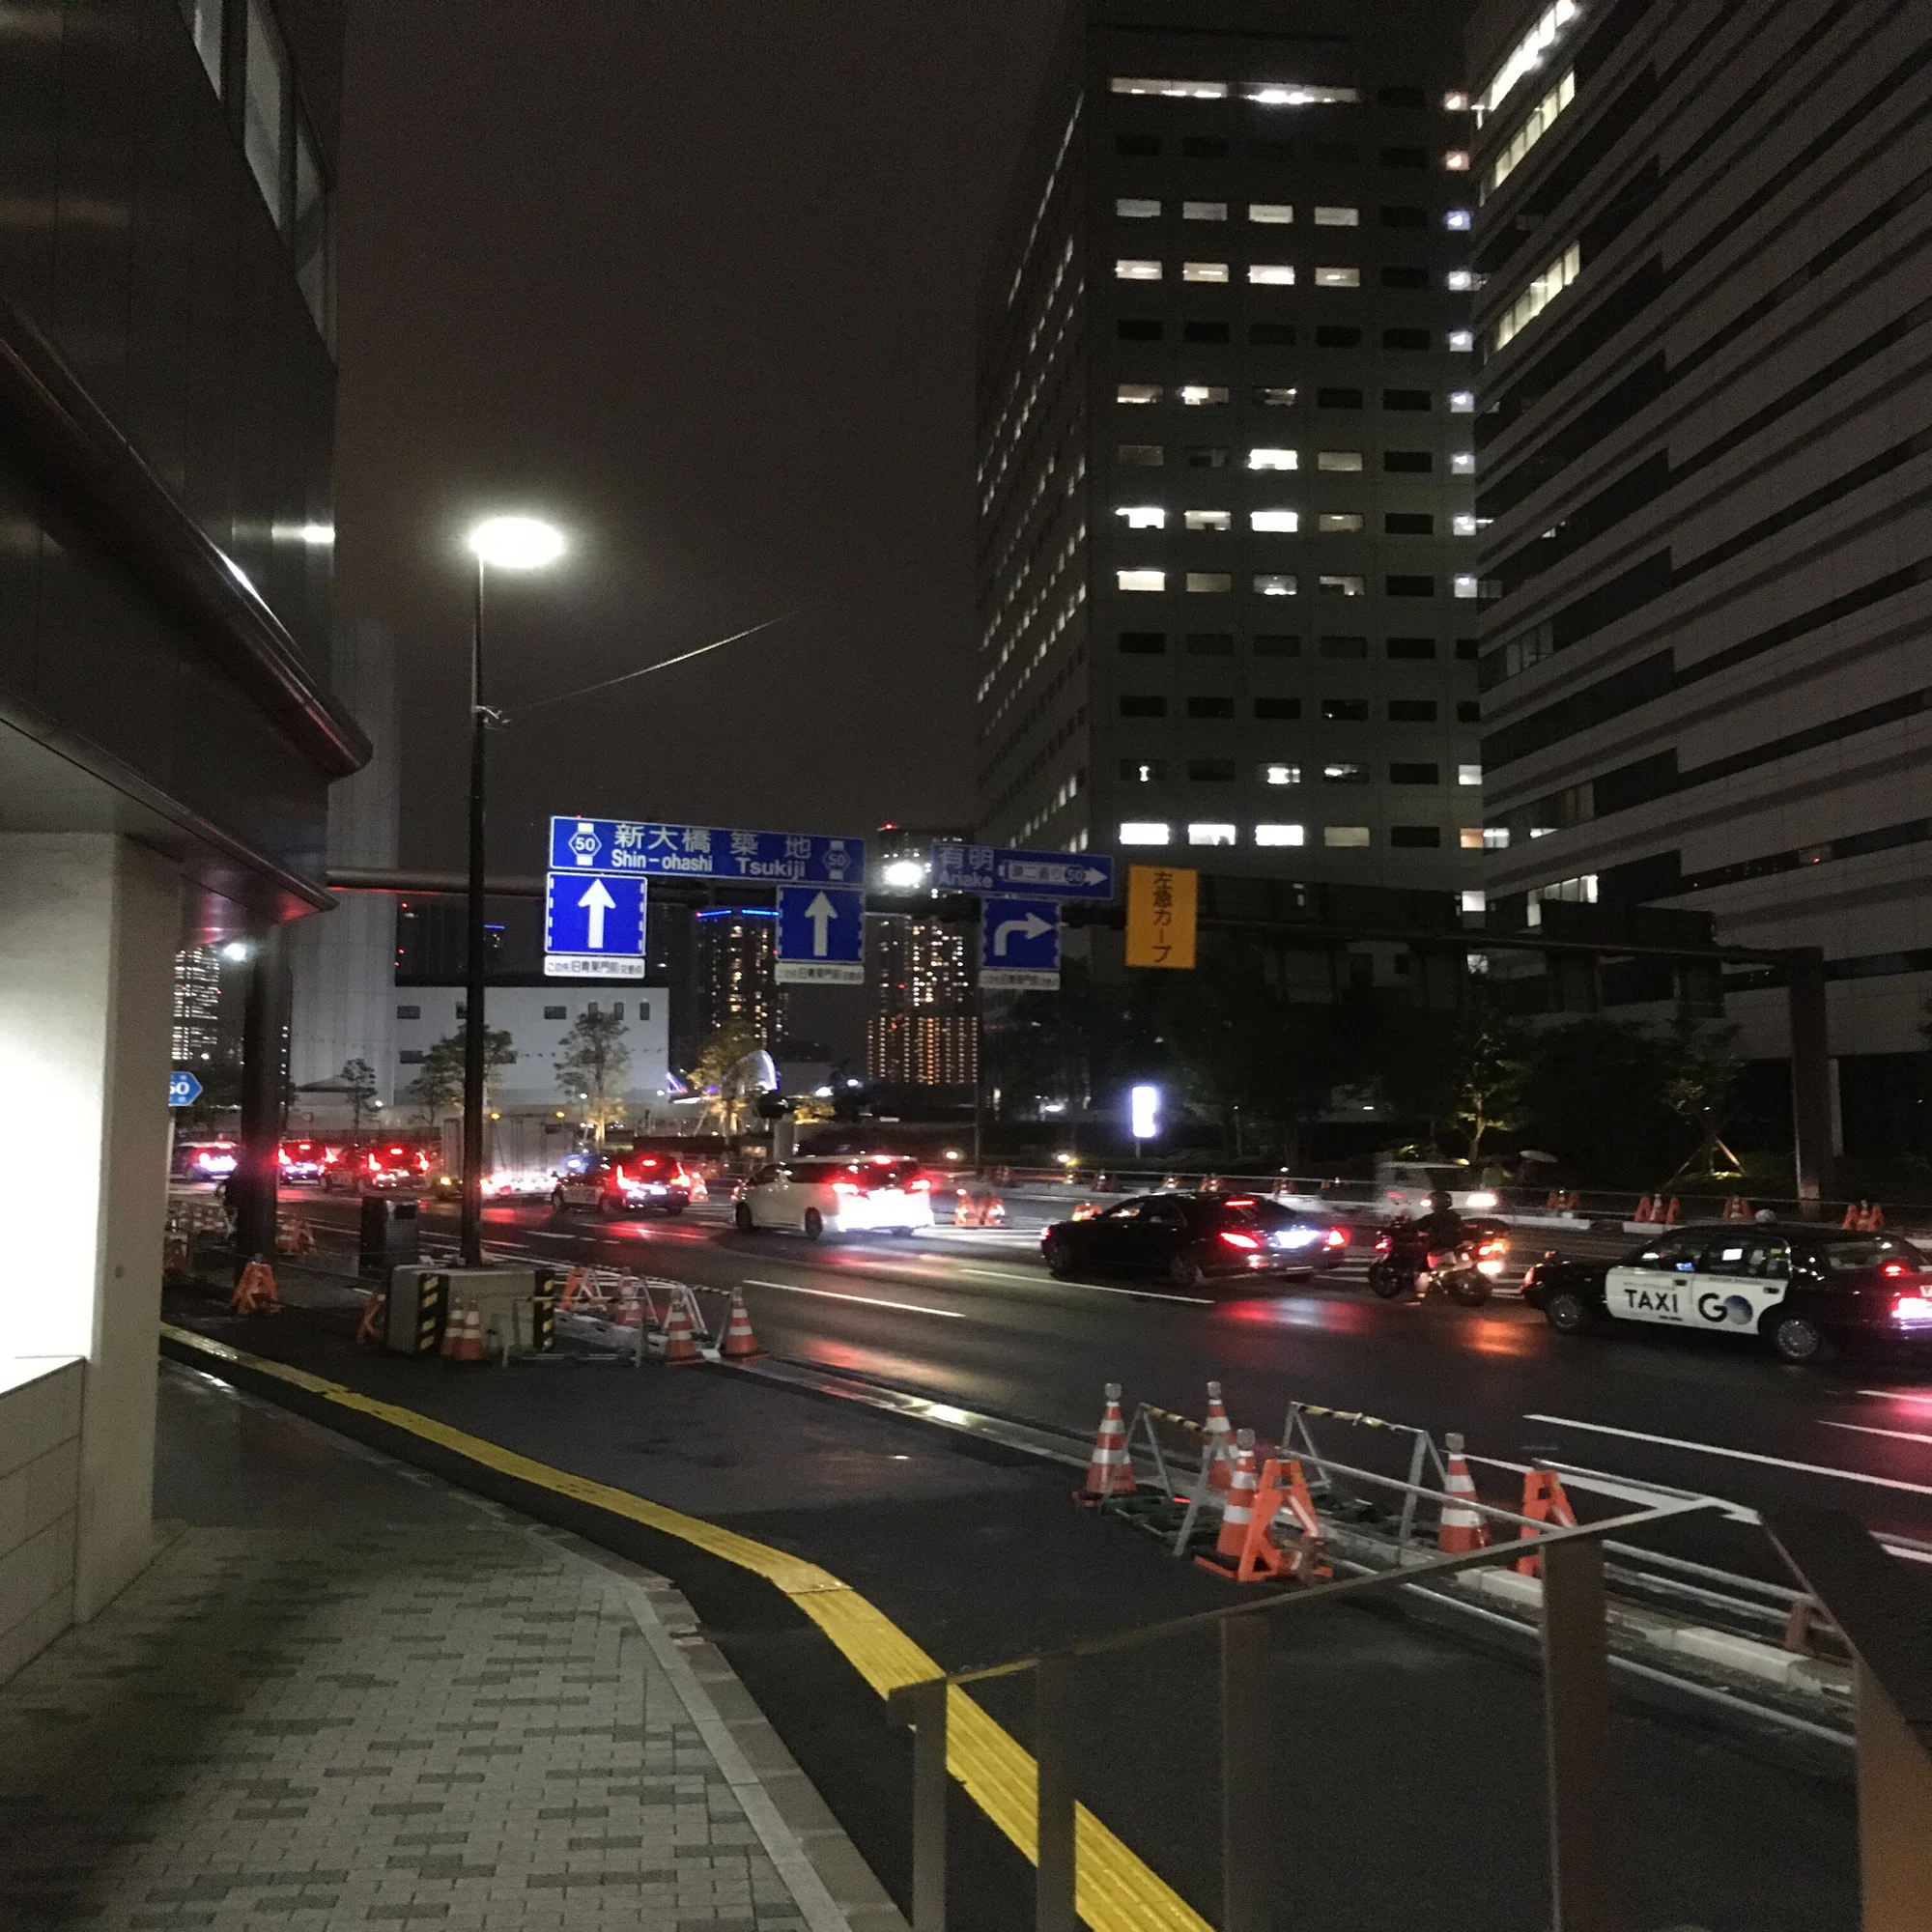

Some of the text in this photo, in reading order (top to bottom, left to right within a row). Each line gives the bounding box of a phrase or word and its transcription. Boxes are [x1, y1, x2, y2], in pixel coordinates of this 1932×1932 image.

[575, 837, 596, 851] 50
[613, 824, 712, 854] 新大橋
[735, 856, 806, 881] Tsukiji
[828, 853, 846, 867] 50
[1624, 1288, 1679, 1313] TAXI
